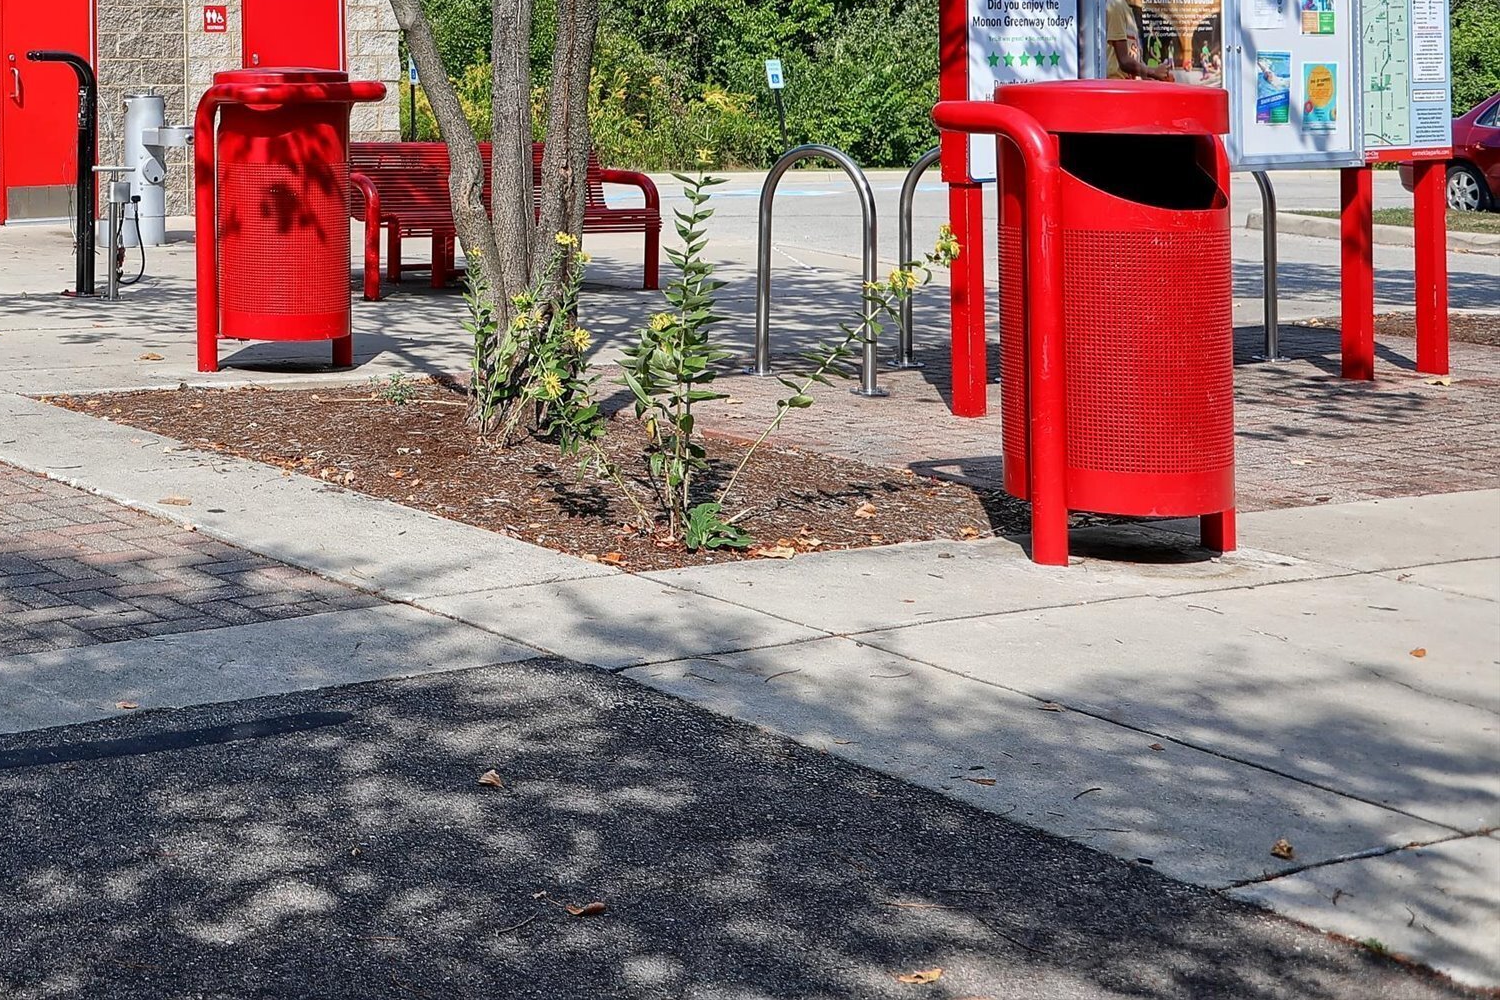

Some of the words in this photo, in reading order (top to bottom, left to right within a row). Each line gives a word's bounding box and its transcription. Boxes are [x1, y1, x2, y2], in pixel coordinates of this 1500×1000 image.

[1004, 1, 1020, 13] you
[972, 15, 1002, 28] Monon
[1004, 15, 1045, 30] Greenway
[1047, 15, 1074, 30] today?
